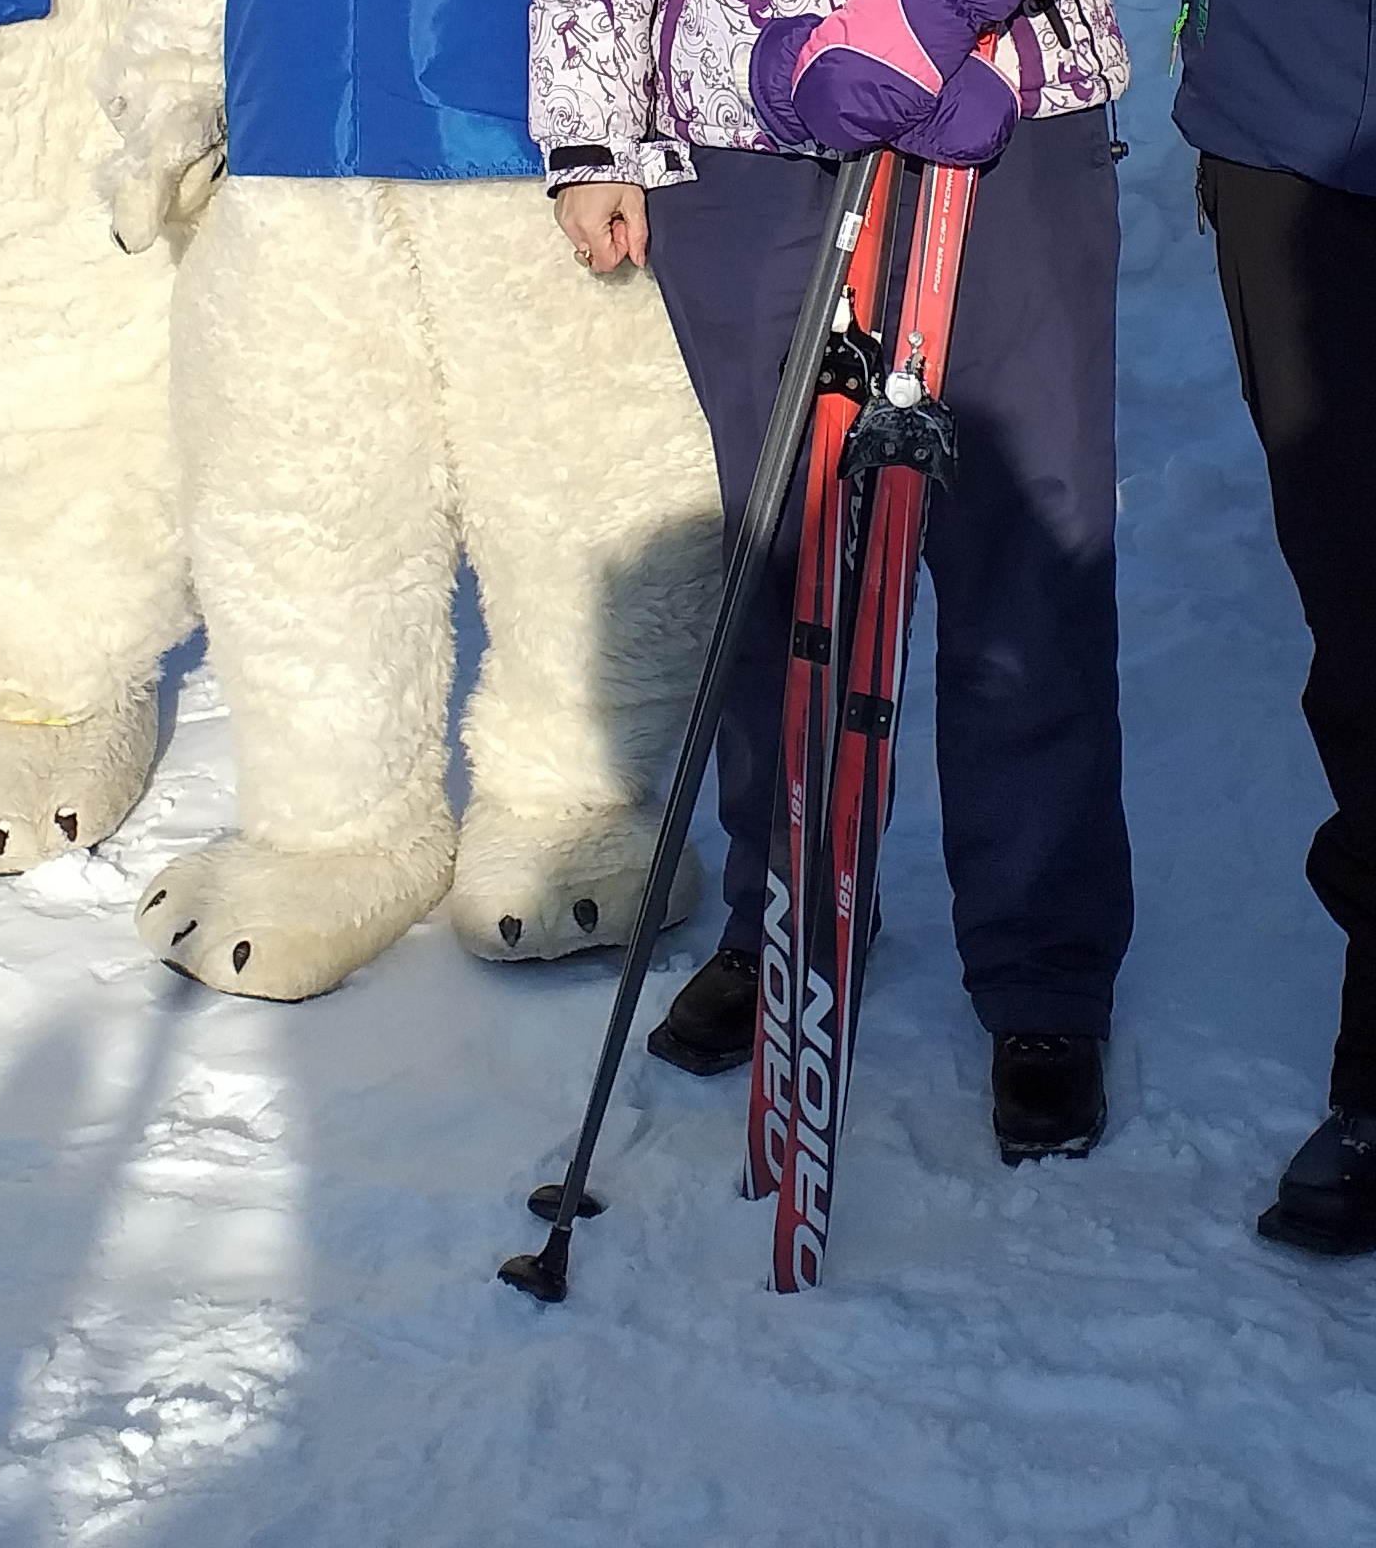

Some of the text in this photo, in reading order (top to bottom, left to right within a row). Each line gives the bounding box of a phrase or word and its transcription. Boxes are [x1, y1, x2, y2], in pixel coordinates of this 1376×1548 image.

[789, 779, 803, 827] 185
[836, 870, 853, 920] 185
[791, 965, 836, 1290] ORION
